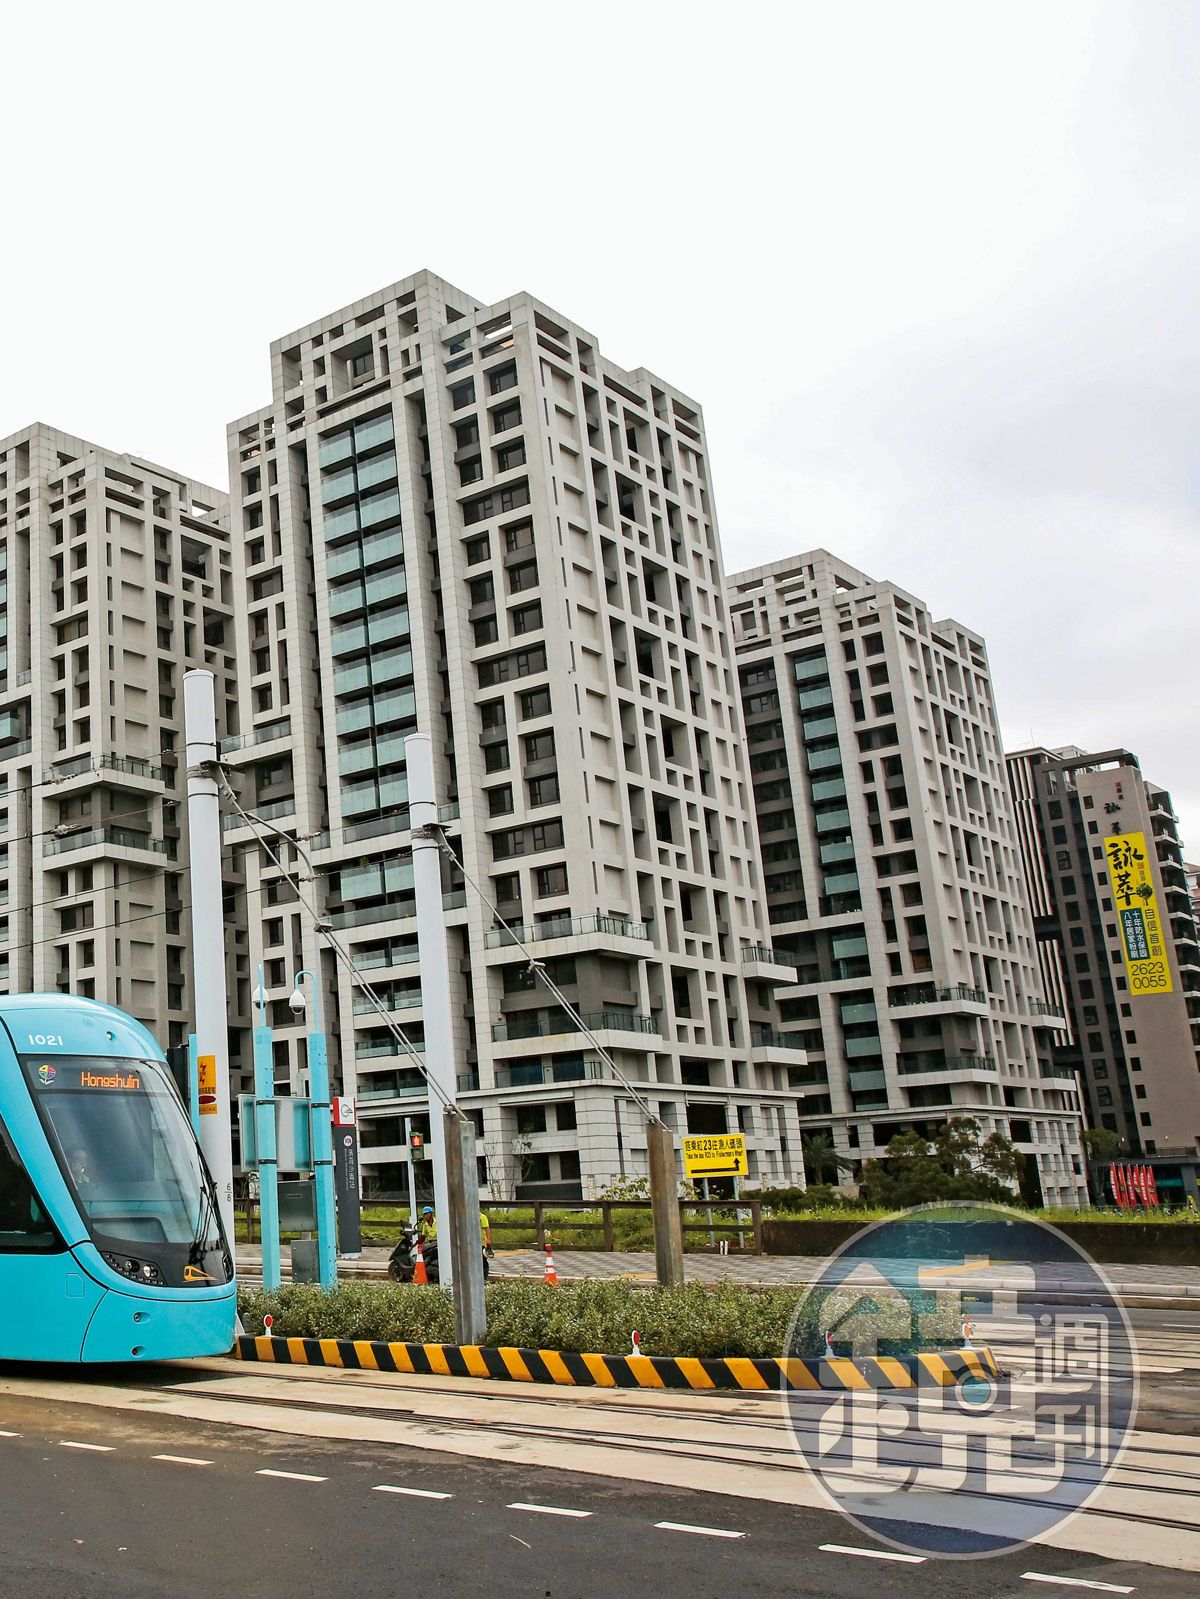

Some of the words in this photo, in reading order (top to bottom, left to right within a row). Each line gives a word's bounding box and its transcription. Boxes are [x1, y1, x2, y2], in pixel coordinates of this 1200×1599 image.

[1131, 961, 1165, 976] 2623
[1133, 974, 1167, 990] 0055
[28, 1034, 63, 1046] 1021
